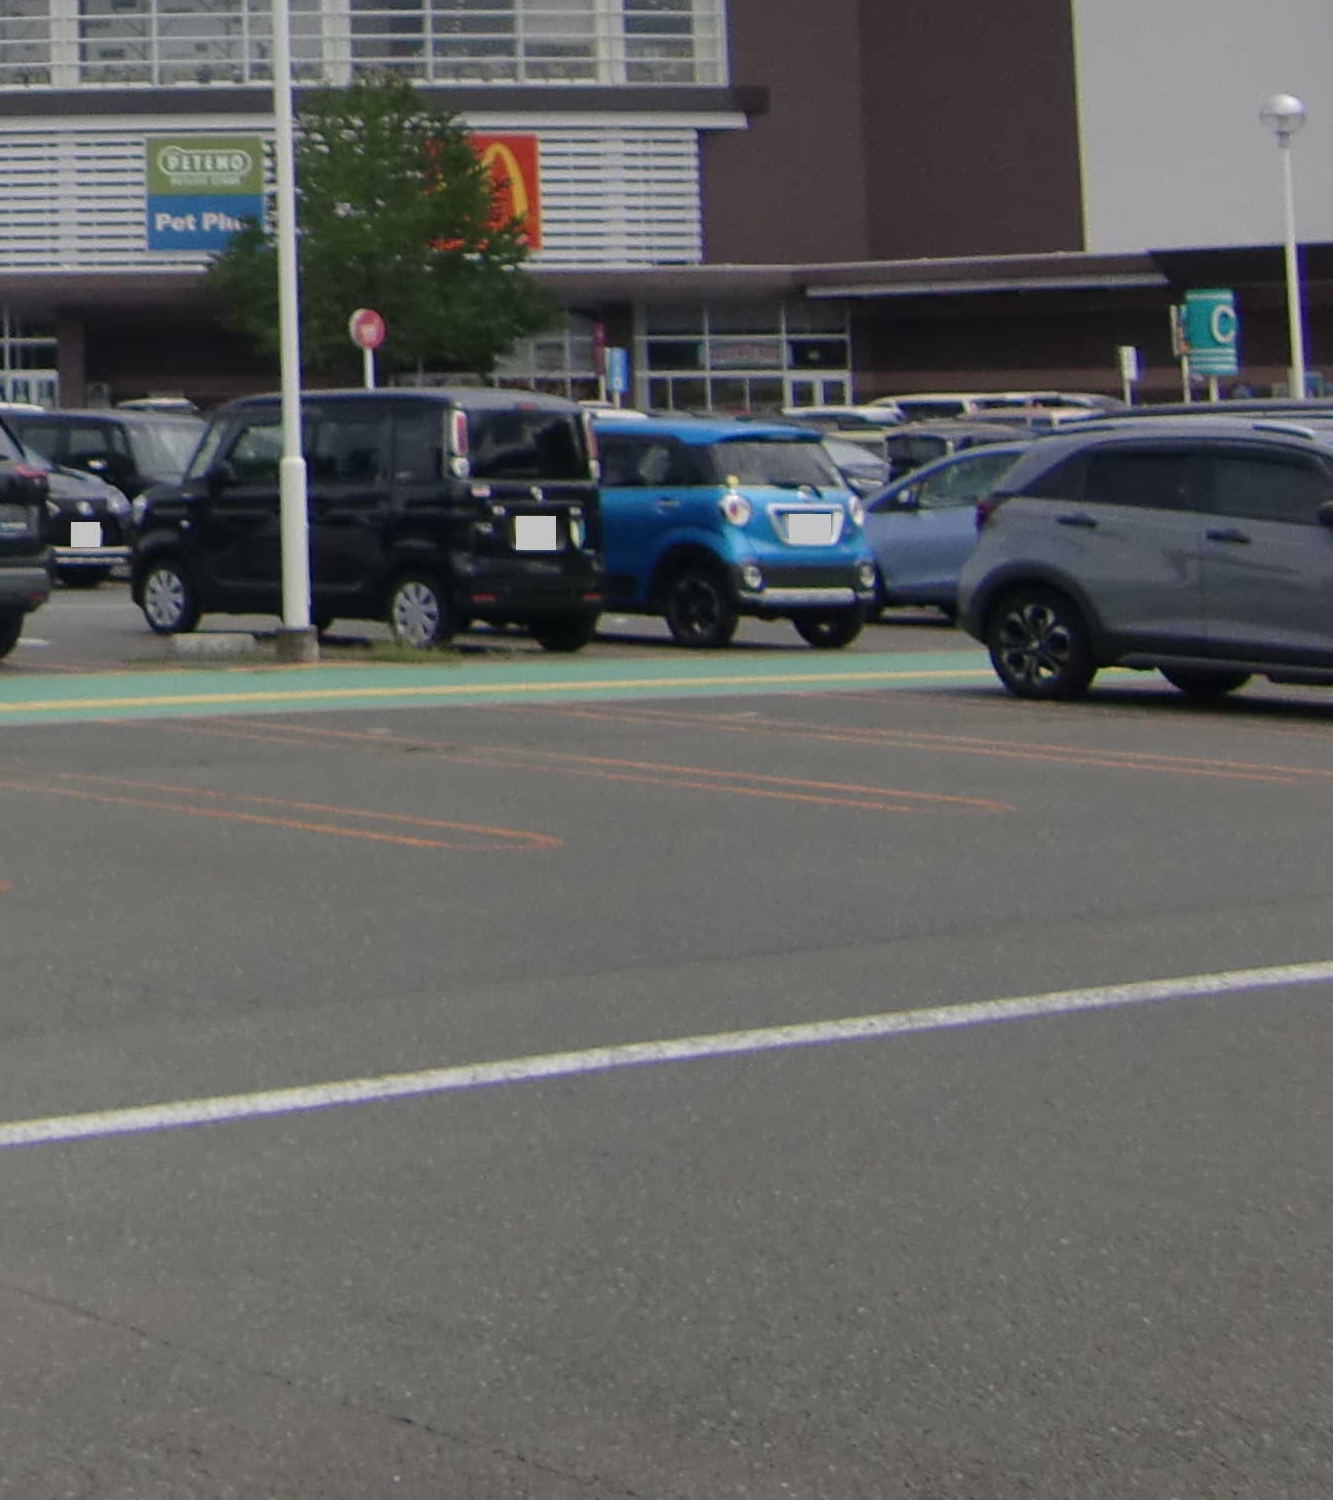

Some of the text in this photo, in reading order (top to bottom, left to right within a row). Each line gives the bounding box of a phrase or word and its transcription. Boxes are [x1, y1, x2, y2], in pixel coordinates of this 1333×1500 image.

[155, 212, 247, 232] Pet Plu
[1211, 304, 1237, 344] C
